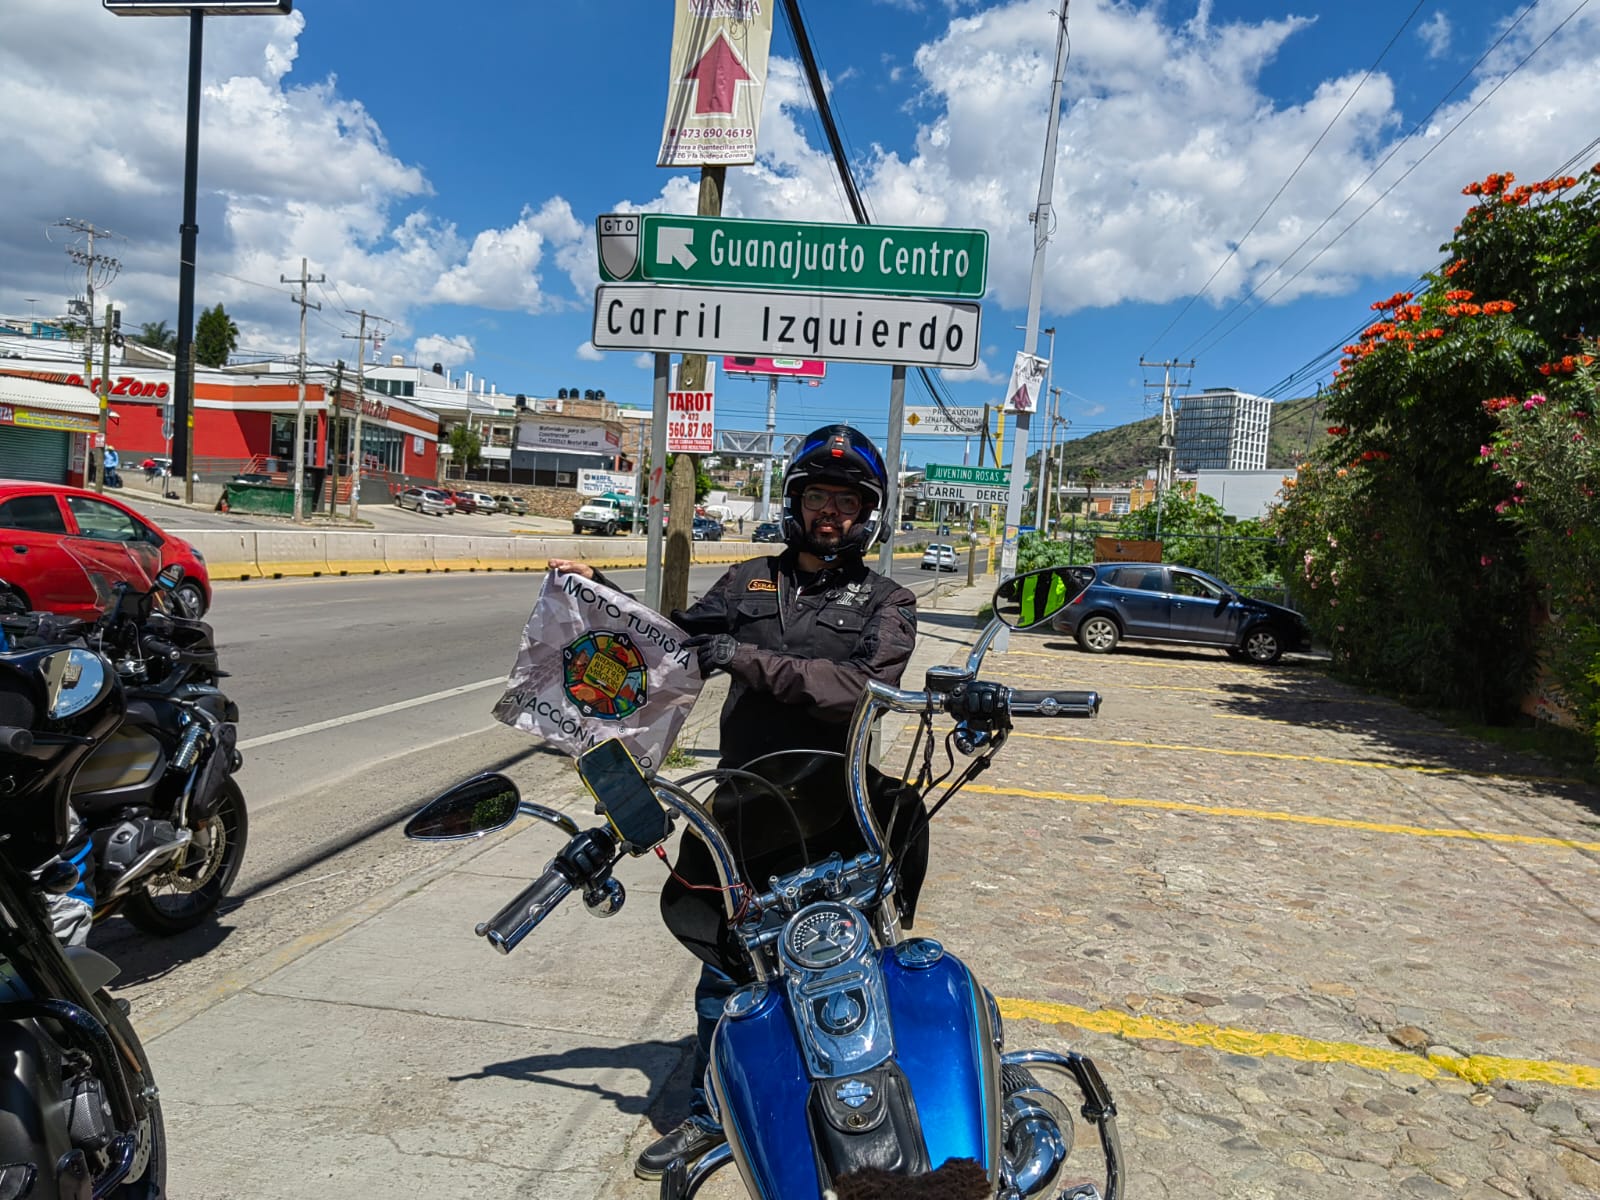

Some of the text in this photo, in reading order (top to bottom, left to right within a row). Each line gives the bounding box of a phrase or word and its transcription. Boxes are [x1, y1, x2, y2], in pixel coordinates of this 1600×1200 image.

[680, 128, 752, 138] 473 690 4619
[697, 143, 735, 151] Puentecillas
[604, 220, 634, 231] GTO
[710, 229, 969, 279] Guanajuato Centro
[607, 299, 963, 354] Carril Izquierdo
[668, 392, 713, 411] TAROT
[701, 422, 712, 437] 08
[934, 468, 1000, 481] JUVENTINO ROSAS
[928, 486, 965, 498] CARRIL
[563, 576, 691, 670] MOTO TURISTA
[525, 697, 587, 742] ACCIÓN
